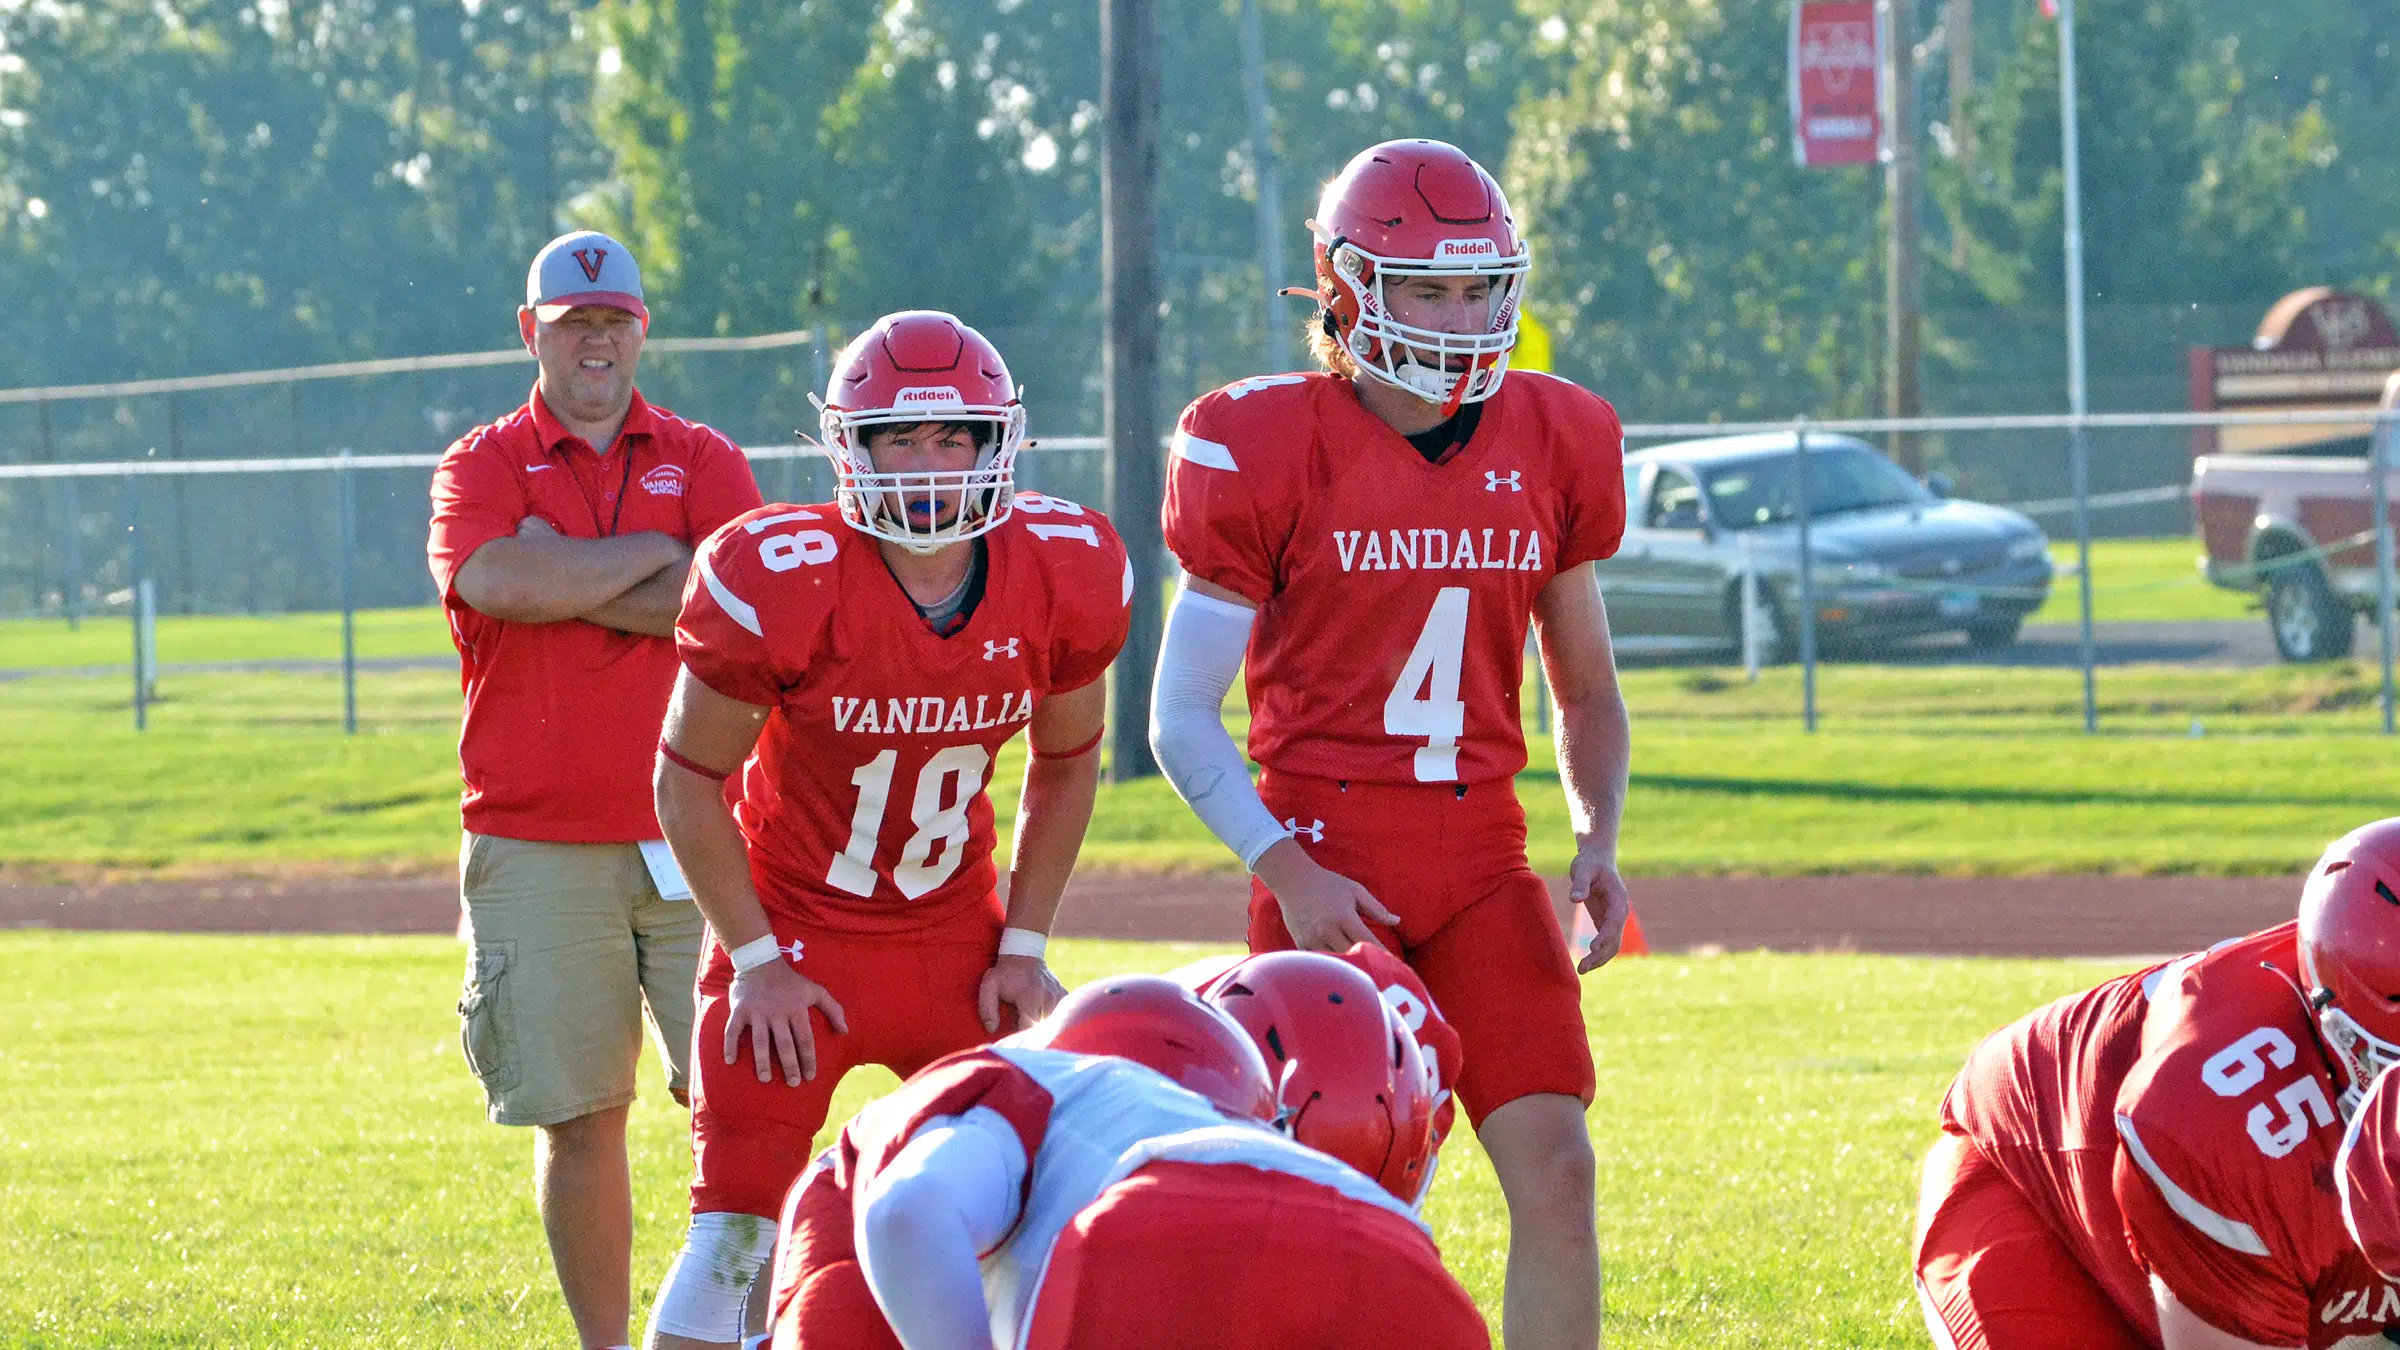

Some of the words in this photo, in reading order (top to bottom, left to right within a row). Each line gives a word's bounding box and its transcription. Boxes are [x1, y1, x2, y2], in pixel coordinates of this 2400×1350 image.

[571, 248, 608, 283] V
[1444, 241, 1493, 255] Riddell
[1490, 296, 1514, 334] Riddell
[1225, 376, 1307, 401] 4
[743, 510, 839, 573] 18
[1013, 495, 1100, 548] 18
[1333, 528, 1542, 572] VANDALIA
[1384, 586, 1470, 782] 4
[831, 689, 1033, 734] VANDALIA
[825, 743, 990, 901] 18
[2202, 1026, 2335, 1159] 65
